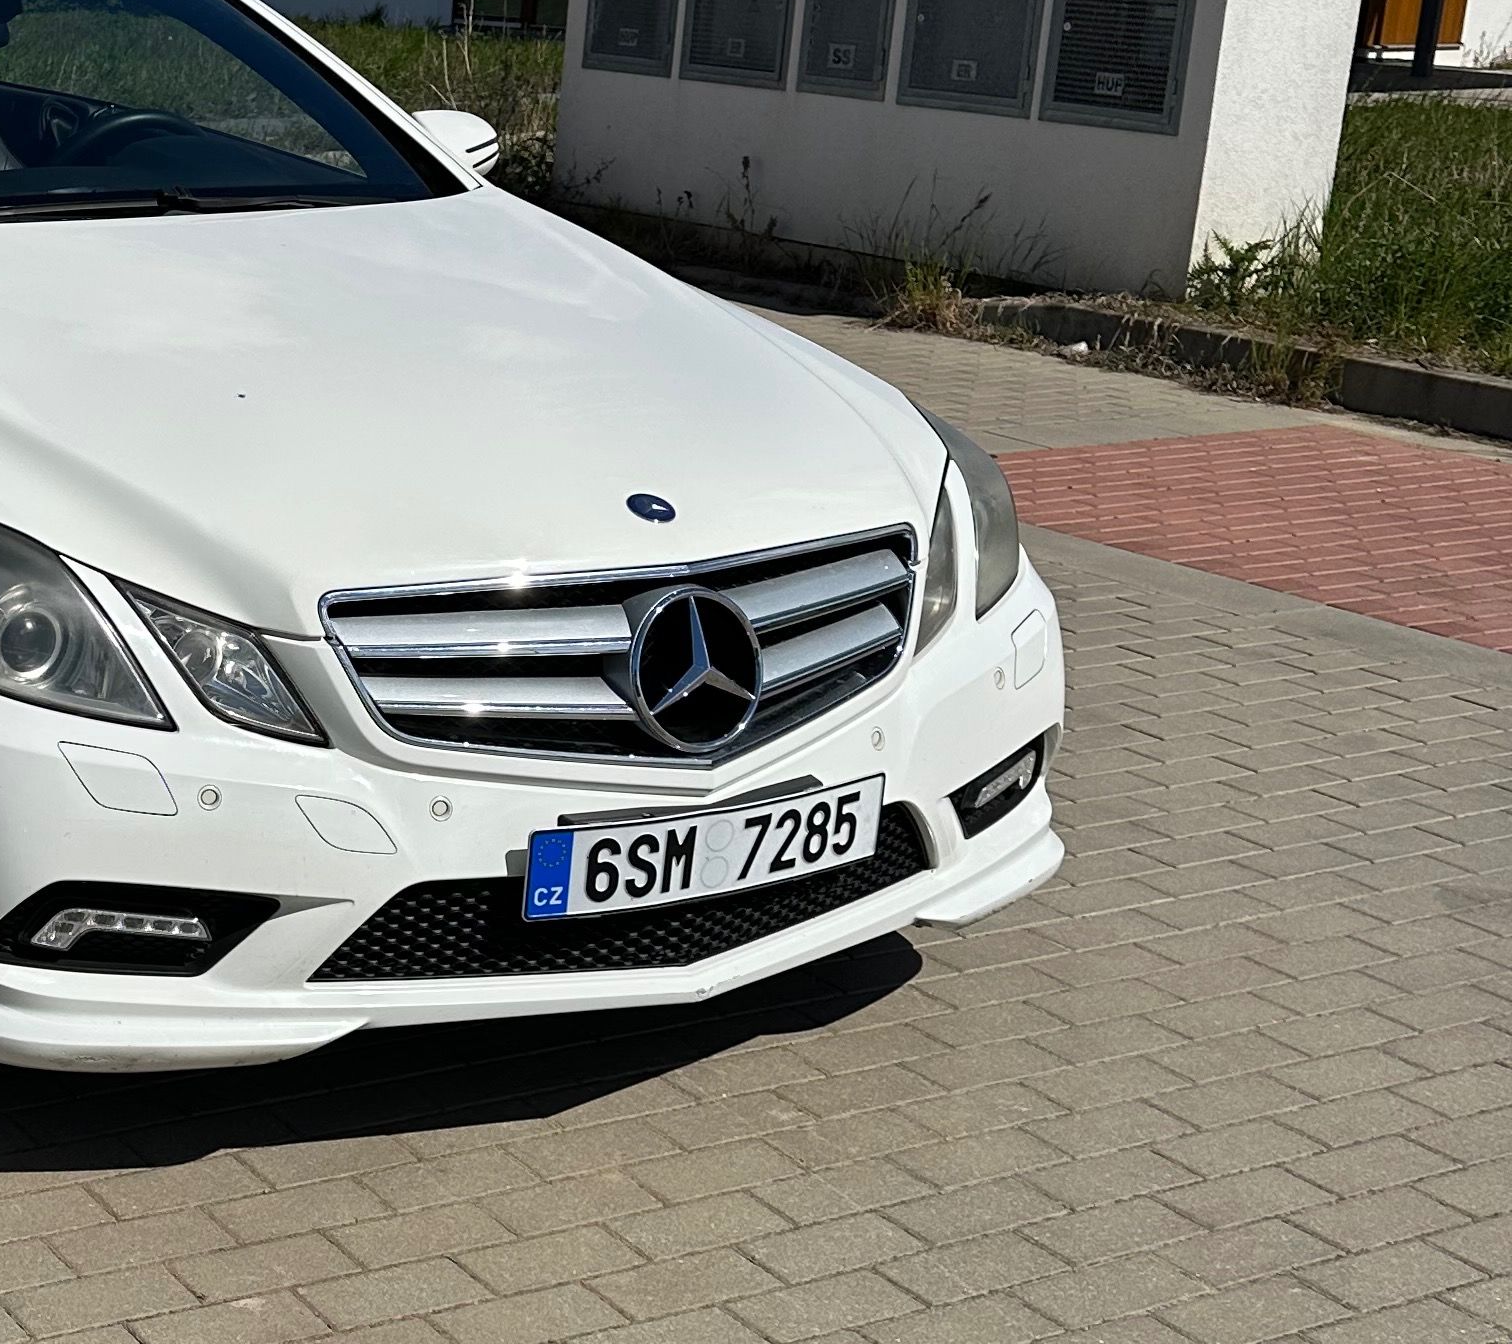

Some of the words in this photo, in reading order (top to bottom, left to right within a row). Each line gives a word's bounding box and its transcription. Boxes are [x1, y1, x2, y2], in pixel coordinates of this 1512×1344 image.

[832, 47, 851, 65] SS
[585, 825, 698, 903] 6SM
[737, 791, 861, 881] 7285
[534, 886, 563, 906] CZ
